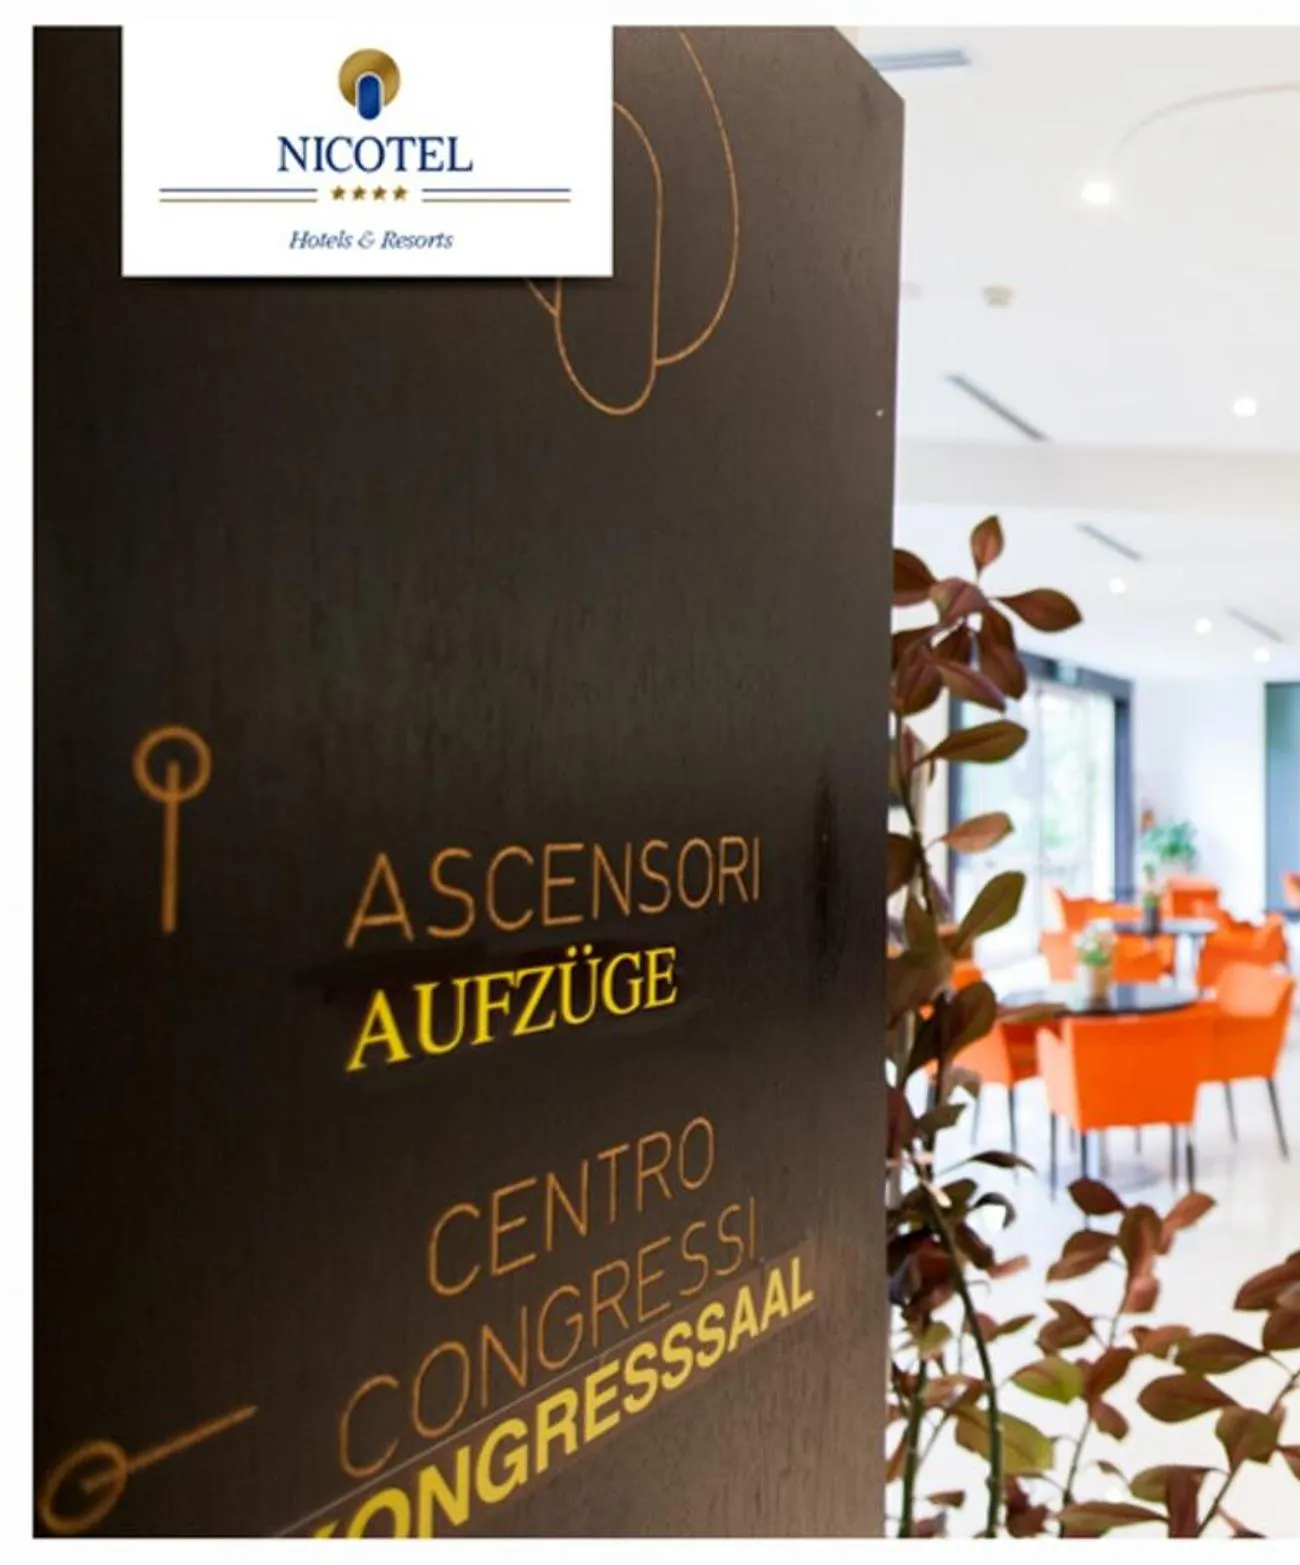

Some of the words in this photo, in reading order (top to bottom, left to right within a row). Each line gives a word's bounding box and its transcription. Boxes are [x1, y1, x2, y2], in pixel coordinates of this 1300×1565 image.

[345, 835, 761, 950] ASCENSORI
[345, 943, 679, 1073] AUFZÜGE
[427, 1116, 715, 1297] CENTRO
[310, 1256, 815, 1539] ONGRESSSAAL
[339, 1196, 756, 1478] CONGRESSI
